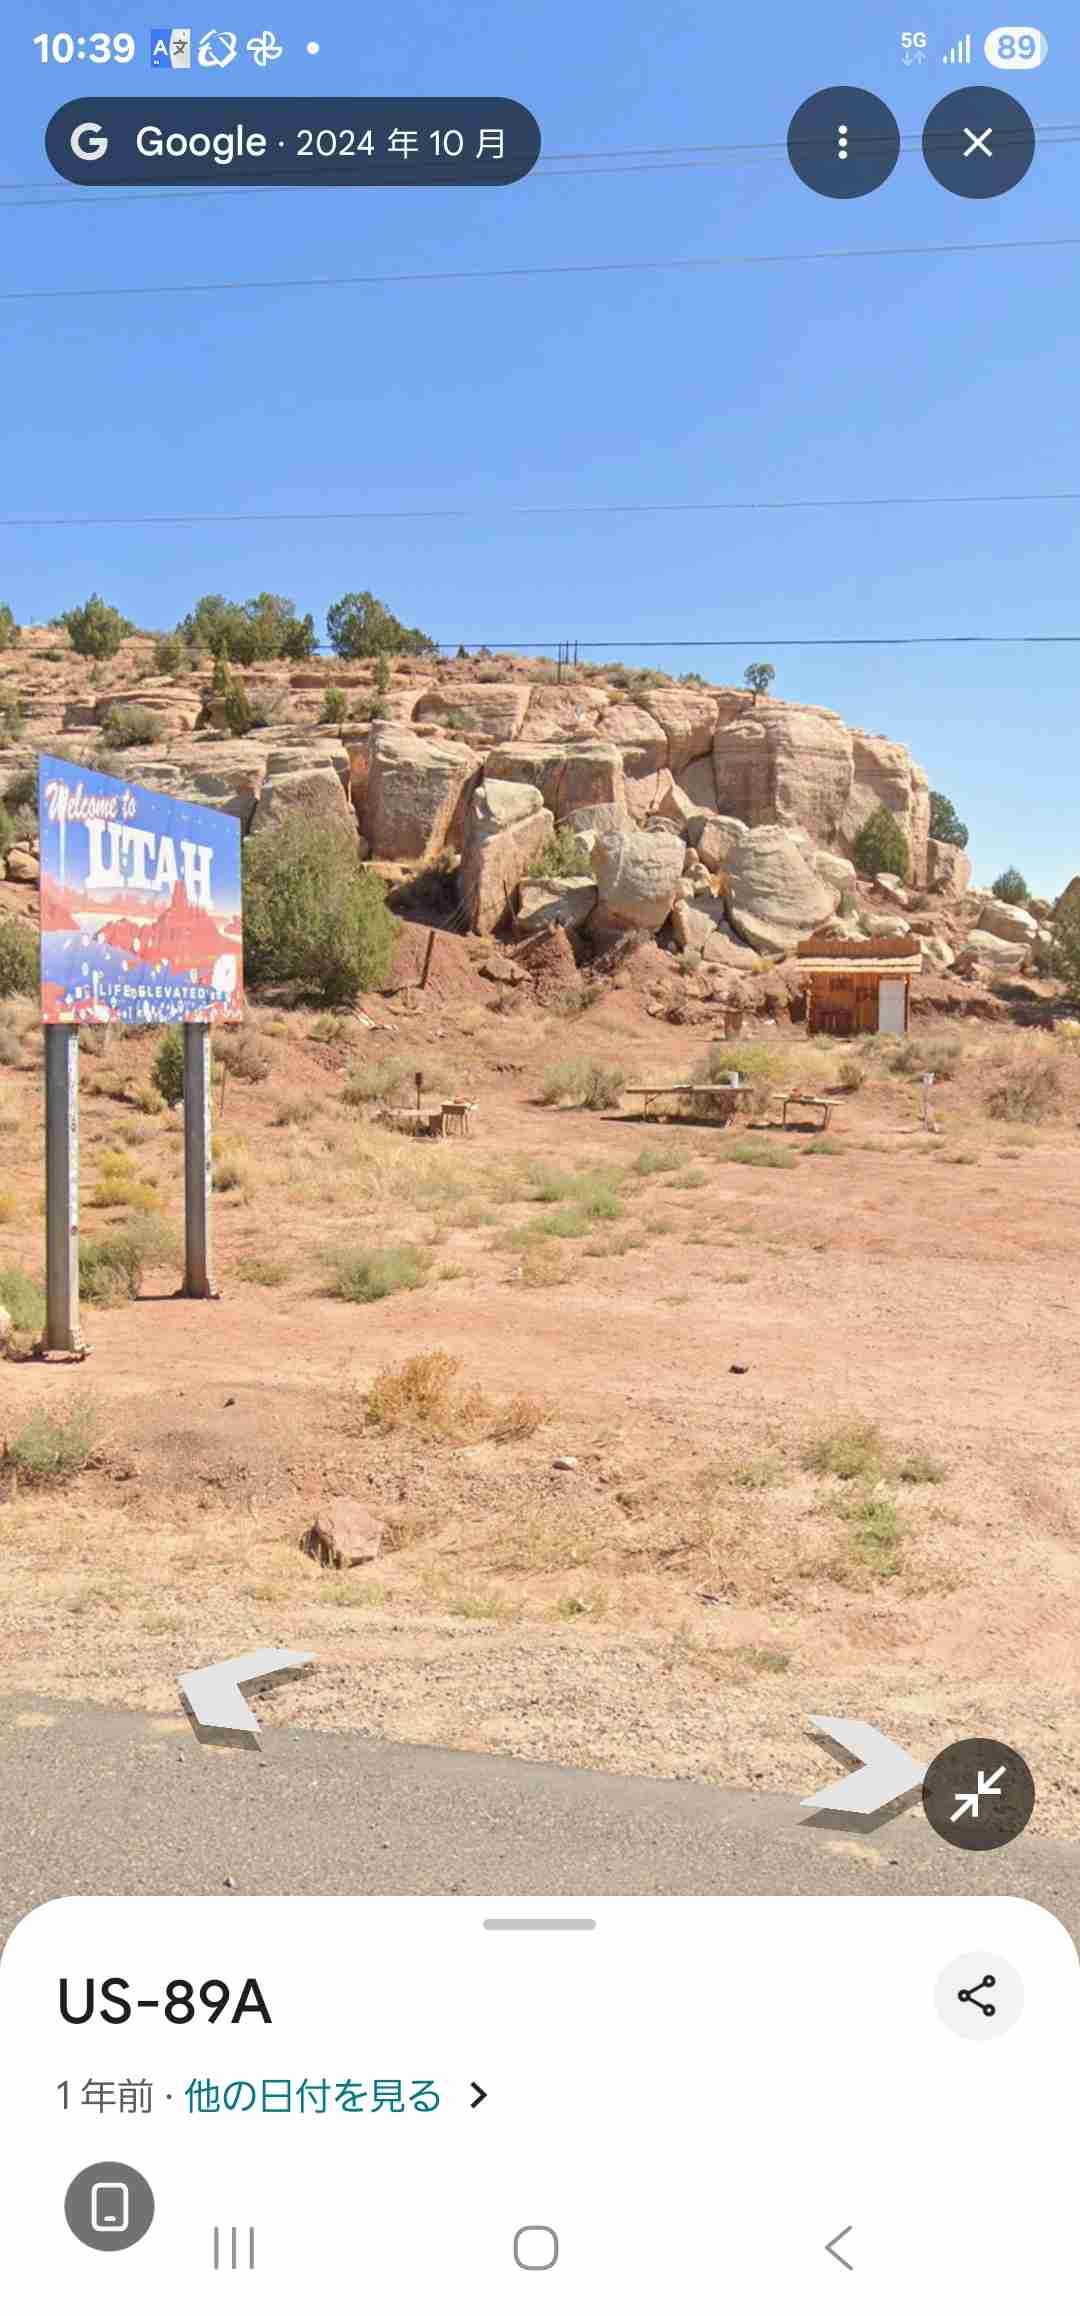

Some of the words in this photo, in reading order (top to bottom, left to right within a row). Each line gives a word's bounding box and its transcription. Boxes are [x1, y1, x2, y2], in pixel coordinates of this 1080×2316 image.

[45, 781, 117, 821] Welcome
[119, 789, 137, 821] to
[83, 818, 215, 910] UTAH
[99, 984, 132, 998] LIFE
